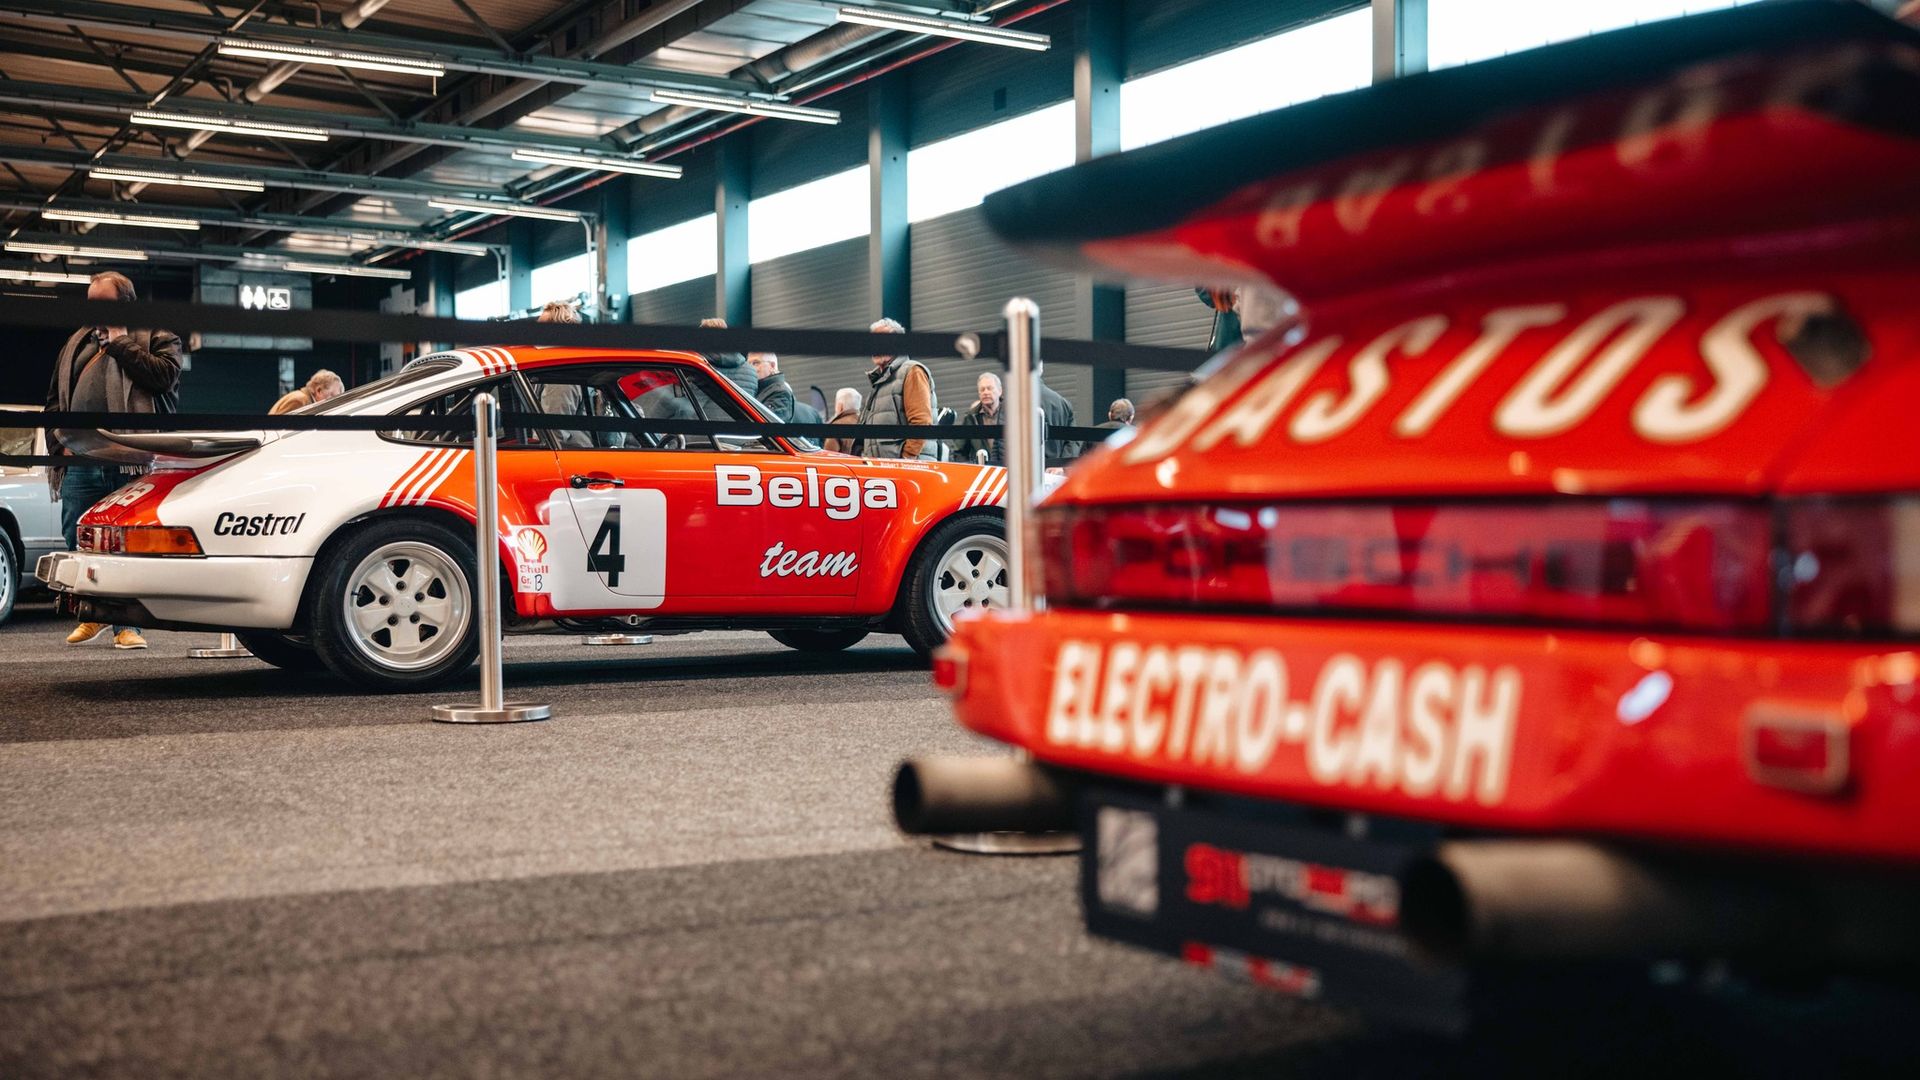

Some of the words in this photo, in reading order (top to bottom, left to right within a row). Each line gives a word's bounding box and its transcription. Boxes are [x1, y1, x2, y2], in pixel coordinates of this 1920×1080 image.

[1121, 291, 1838, 464] BASTOS
[714, 463, 898, 521] Belga
[213, 511, 306, 536] Castrol
[587, 504, 625, 587] 4
[519, 564, 549, 574] Shell
[759, 541, 859, 578] team
